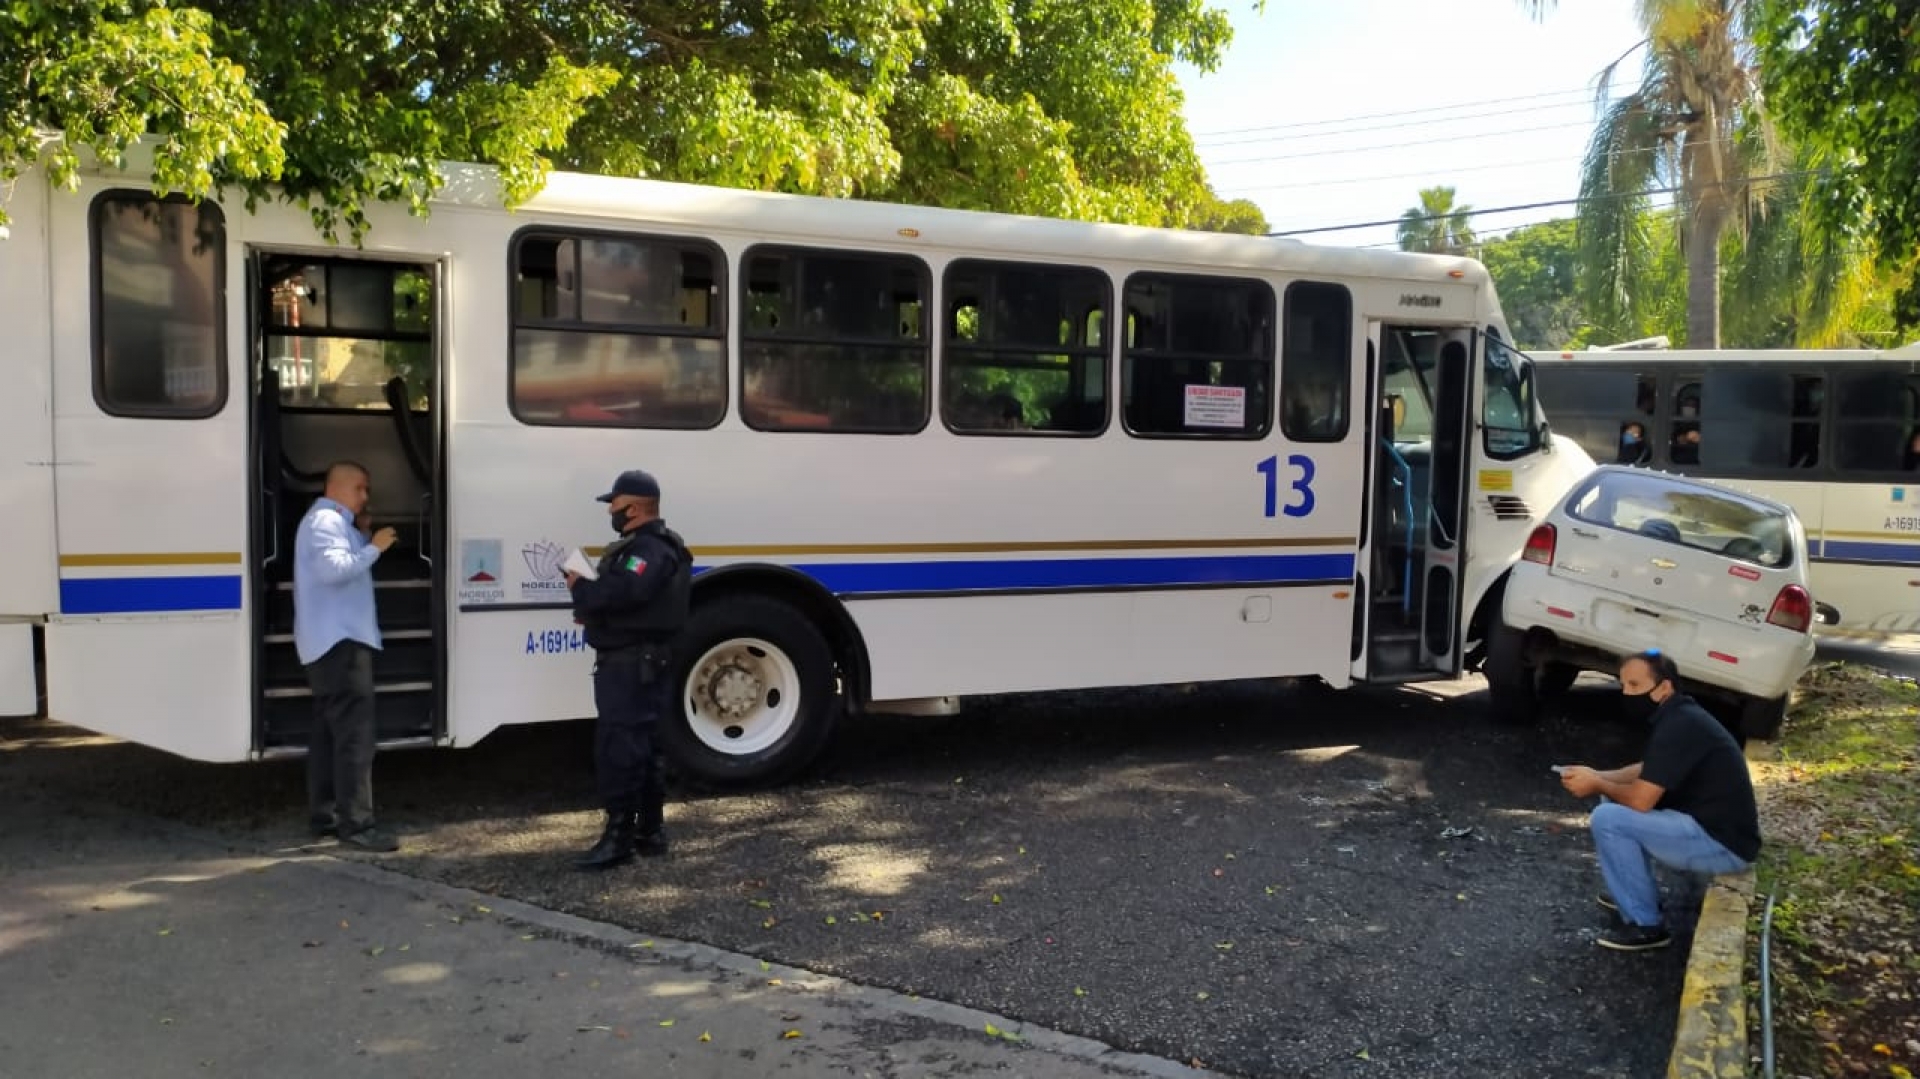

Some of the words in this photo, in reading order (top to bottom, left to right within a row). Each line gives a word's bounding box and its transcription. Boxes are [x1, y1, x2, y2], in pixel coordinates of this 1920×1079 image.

[1257, 454, 1315, 517] 13
[1884, 517, 1920, 531] A-1691
[521, 581, 567, 589] MORELO
